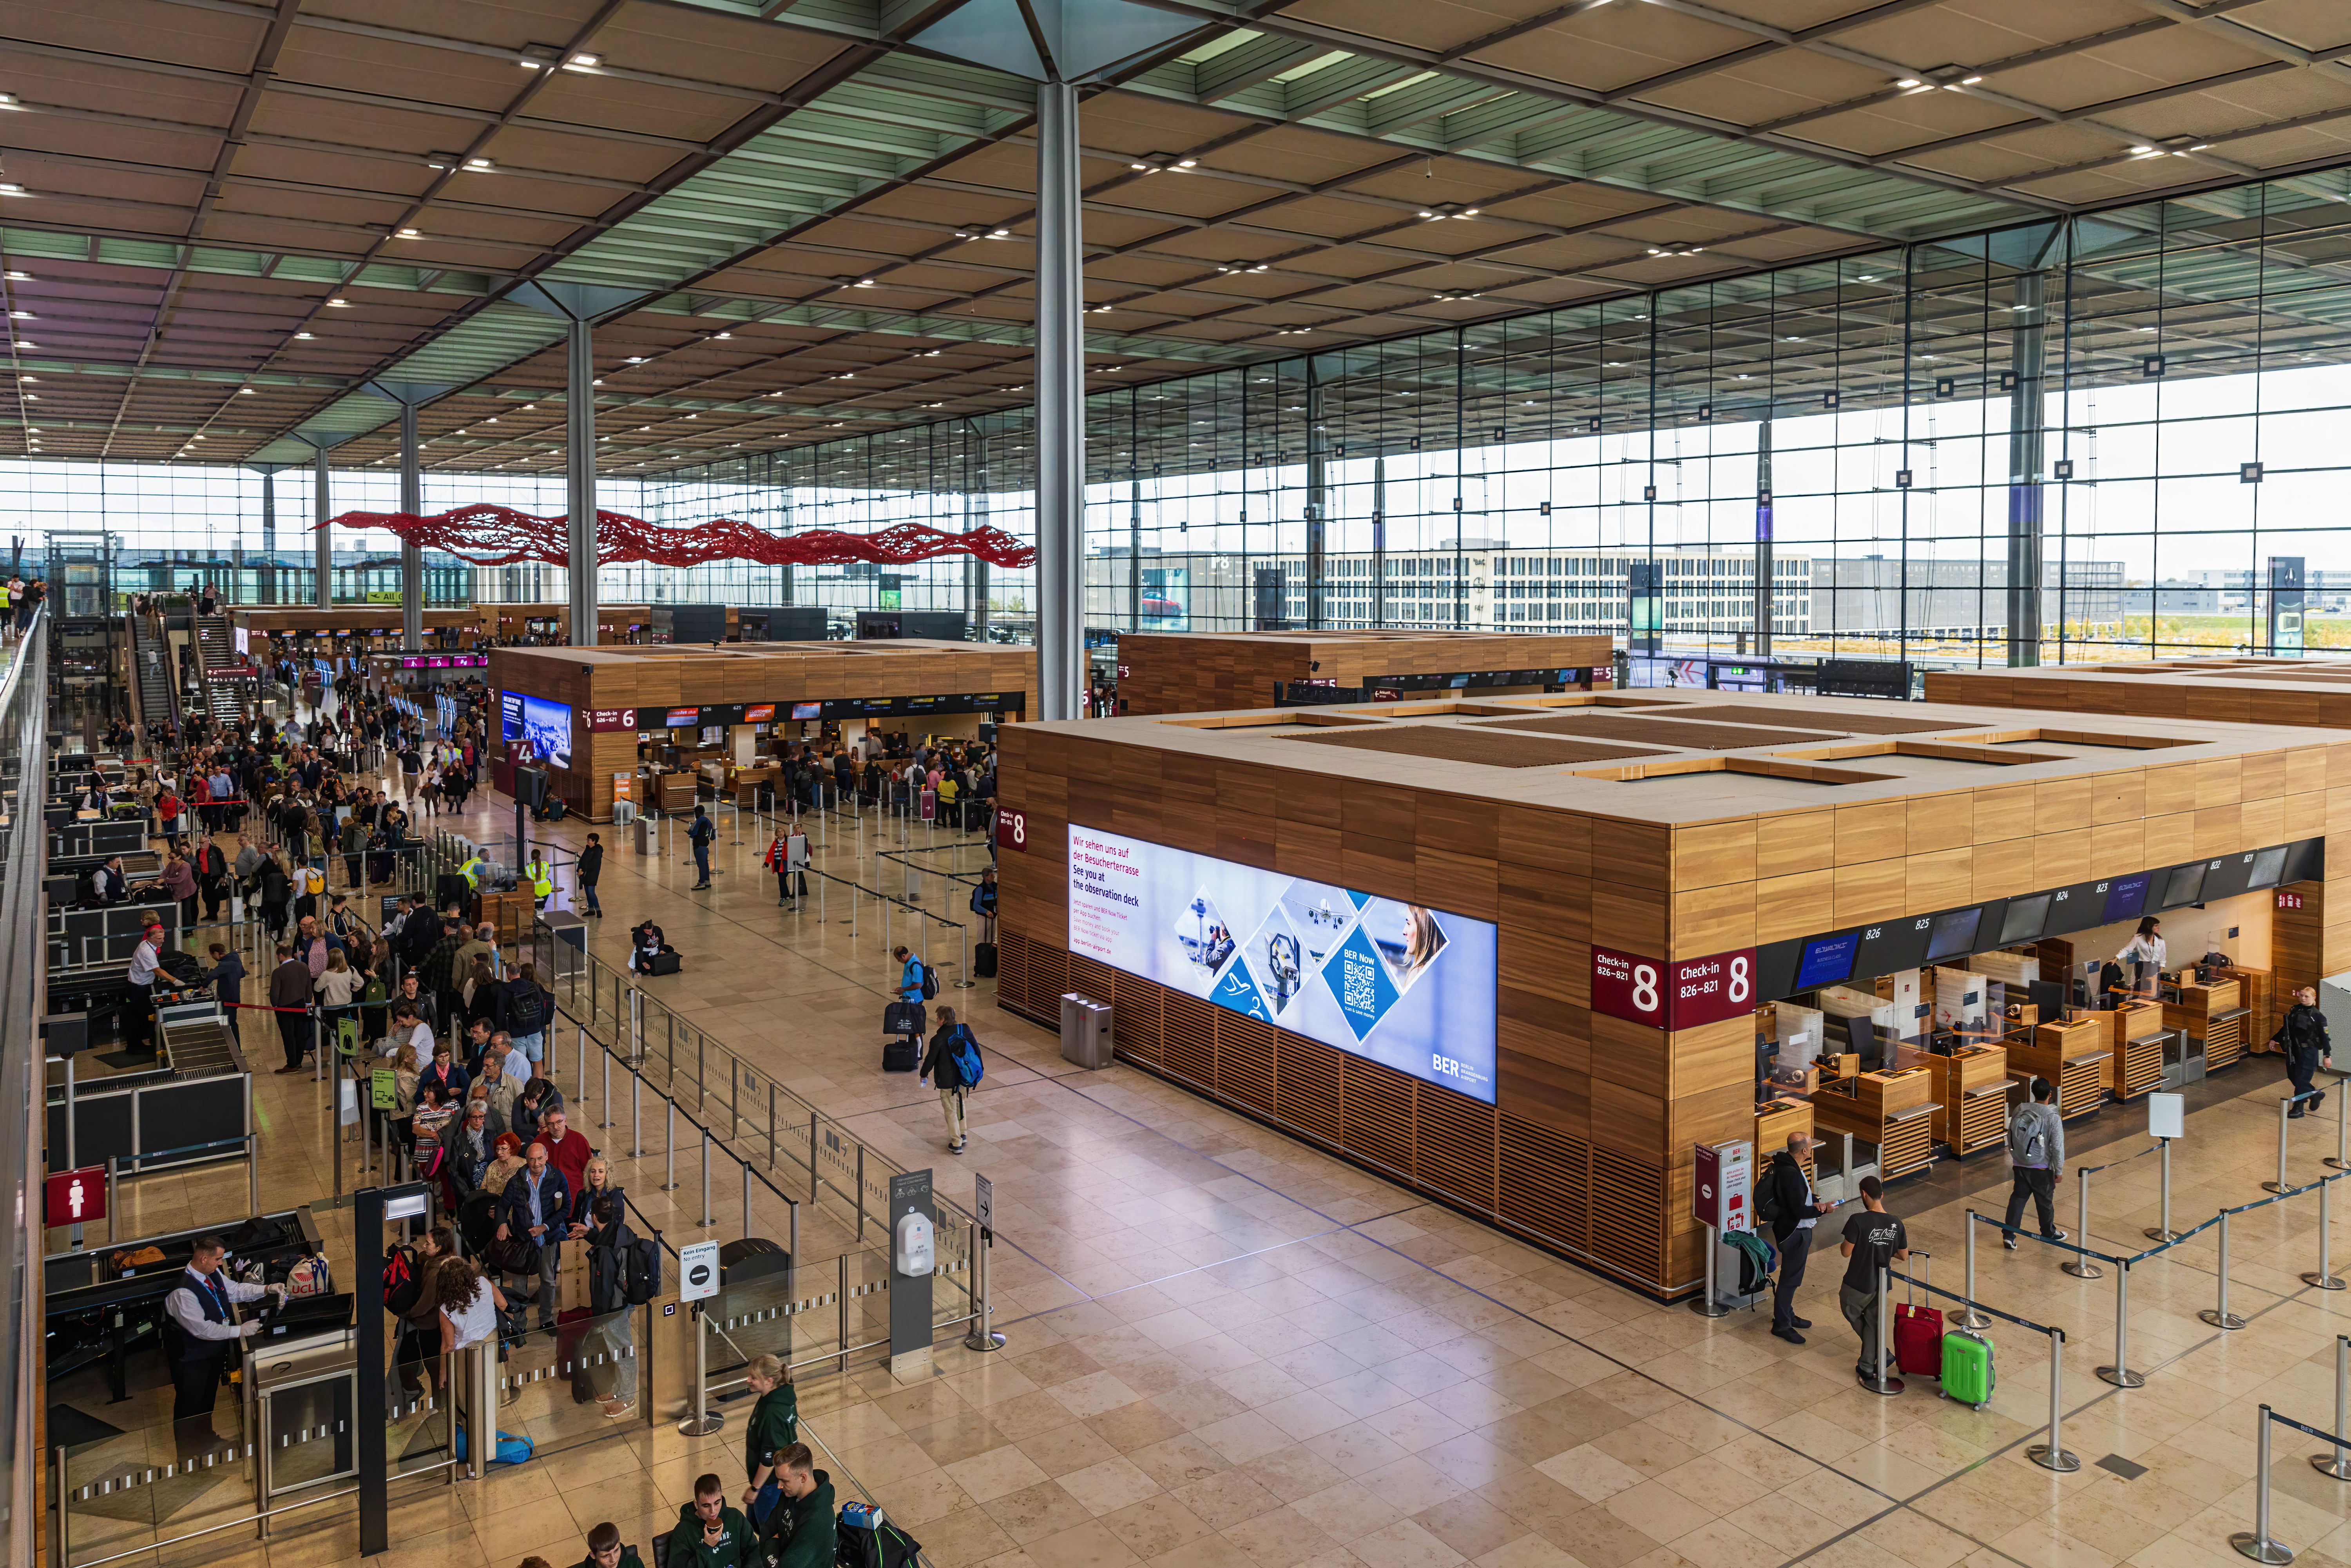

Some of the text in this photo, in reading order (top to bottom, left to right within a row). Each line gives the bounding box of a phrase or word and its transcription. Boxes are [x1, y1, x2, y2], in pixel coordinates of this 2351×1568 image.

[1124, 666, 1129, 677] 5
[1606, 667, 1611, 679] 5
[1083, 690, 1089, 705] 6
[587, 712, 591, 728] 6
[623, 710, 634, 727] 6
[518, 744, 533, 764] 4
[1000, 811, 1024, 844] Check-in 8
[1073, 835, 1129, 858] Wir sehen uns auf
[1073, 849, 1139, 876] der Besucherterrasse
[2210, 860, 2221, 870] 822
[2244, 854, 2254, 863] 821
[1073, 864, 1105, 882] See you at
[1073, 879, 1139, 907] the observation deck
[2096, 882, 2108, 893] 823
[2056, 890, 2068, 901] 824
[1117, 912, 1128, 921] Ticket
[1082, 919, 1093, 929] money
[1915, 918, 1930, 930] 825
[1866, 928, 1881, 940] 826
[1073, 938, 1112, 954] app.berlin-airport.de
[1344, 949, 1375, 965] BER Now
[1597, 954, 1658, 1012] Check-in 8
[1680, 956, 1749, 1003] Check-in 8
[1364, 1012, 1375, 1020] money
[1433, 1053, 1459, 1077] BER
[1461, 1063, 1474, 1071] BERLIN
[1461, 1068, 1489, 1082] BRANDENBURG
[1461, 1075, 1476, 1083] AIRPORT
[292, 1283, 322, 1294] UCL
[2300, 1425, 2313, 1434] BER
